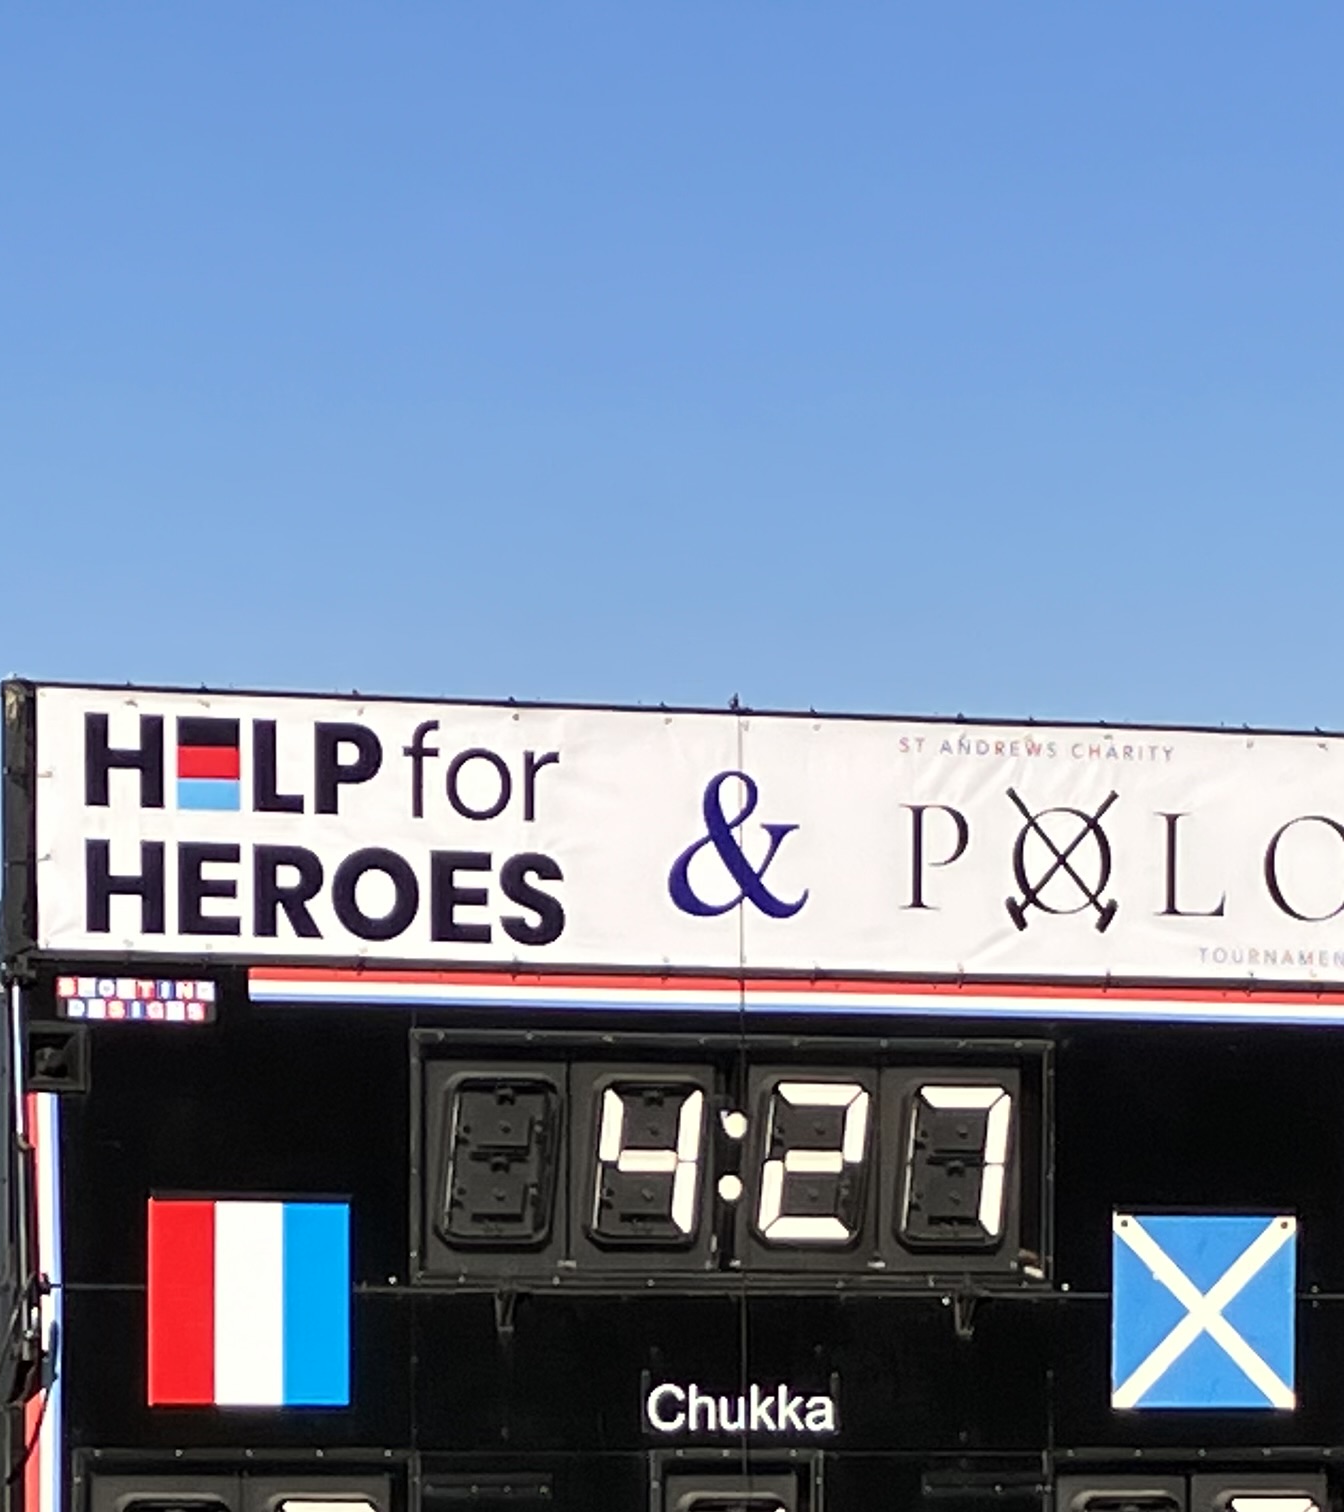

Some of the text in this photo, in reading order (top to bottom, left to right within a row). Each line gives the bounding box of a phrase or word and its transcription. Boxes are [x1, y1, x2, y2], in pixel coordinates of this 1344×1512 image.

[402, 719, 560, 822] for
[899, 736, 1175, 762] ST ANDREWS CHARITY
[86, 839, 565, 946] HEROES
[668, 770, 809, 919] &
[599, 1083, 1012, 1240] 4:27
[648, 1384, 834, 1431] Chukka
